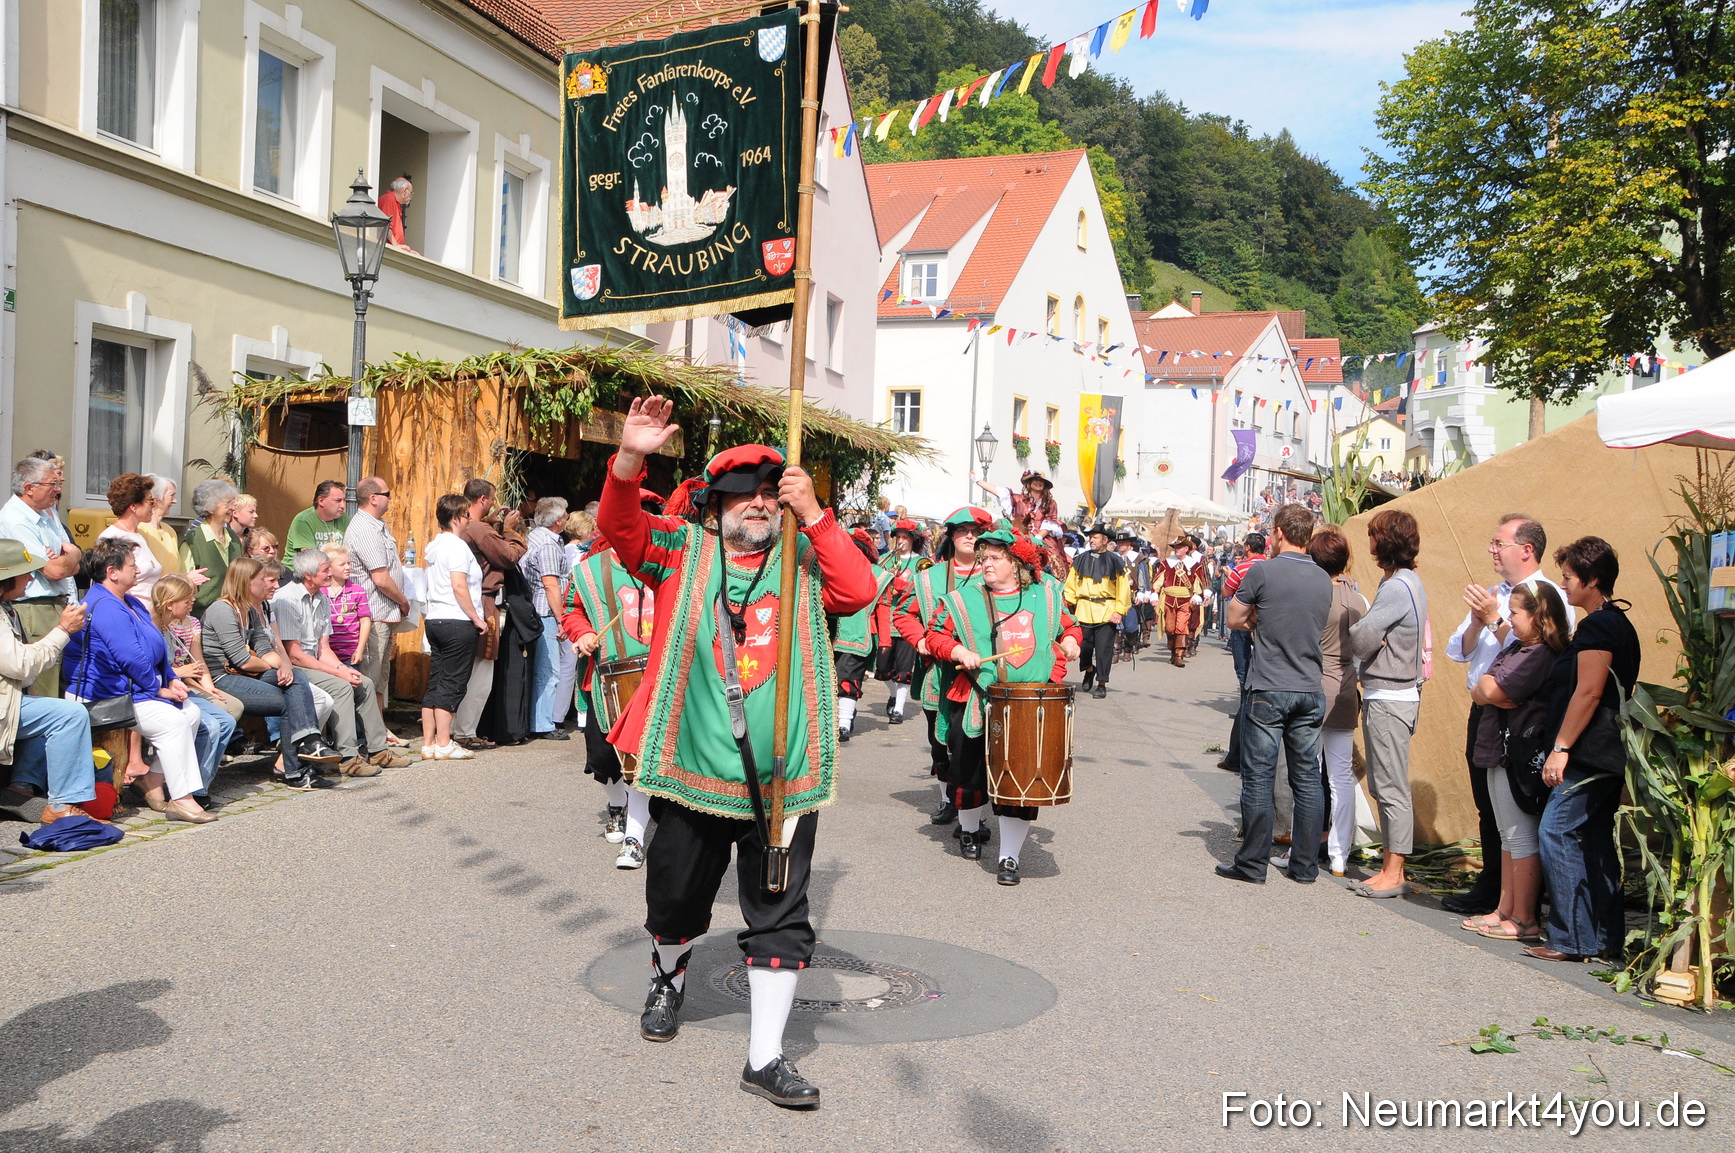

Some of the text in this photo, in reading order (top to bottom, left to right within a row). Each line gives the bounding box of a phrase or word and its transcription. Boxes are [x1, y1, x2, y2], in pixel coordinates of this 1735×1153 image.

[602, 89, 638, 132] Freies
[636, 59, 734, 93] Fanfarenkorps
[739, 145, 772, 168] 1964
[589, 170, 622, 192] gegr.
[613, 221, 752, 276] STRAUBING
